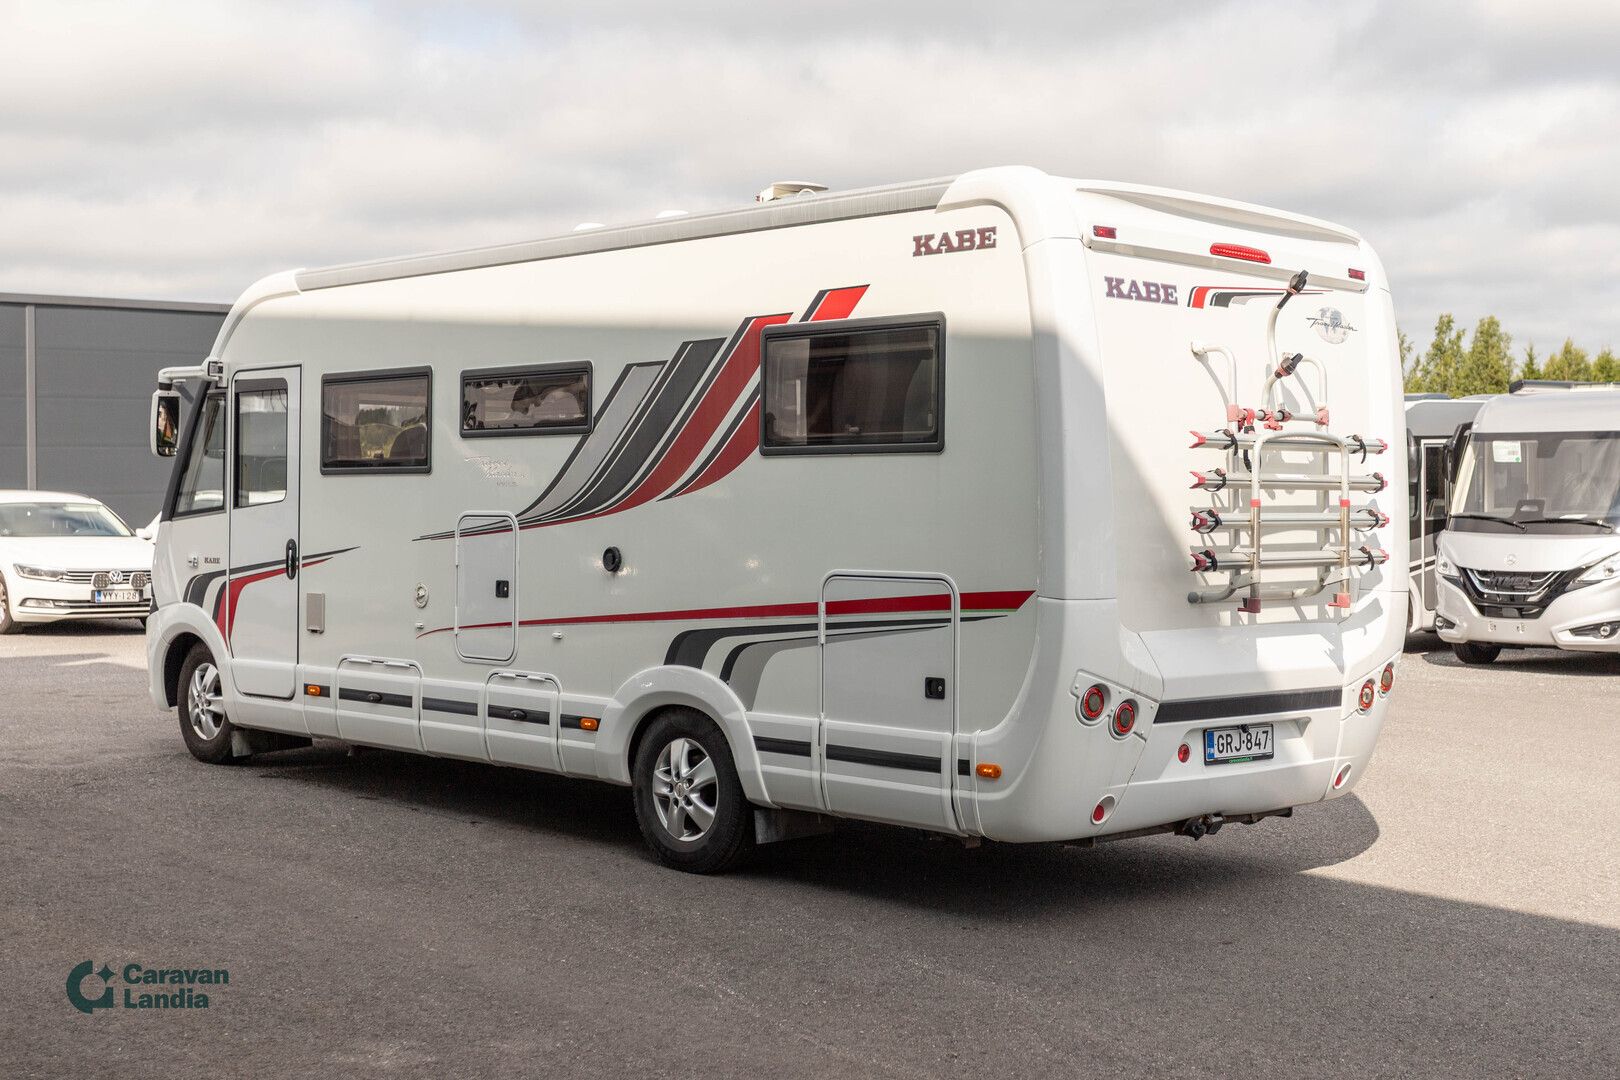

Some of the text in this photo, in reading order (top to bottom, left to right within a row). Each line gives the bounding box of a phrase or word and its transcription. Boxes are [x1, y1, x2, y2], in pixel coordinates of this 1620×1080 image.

[912, 226, 997, 257] KABE
[1104, 276, 1178, 305] KABE
[1217, 730, 1269, 754] GRJ-847
